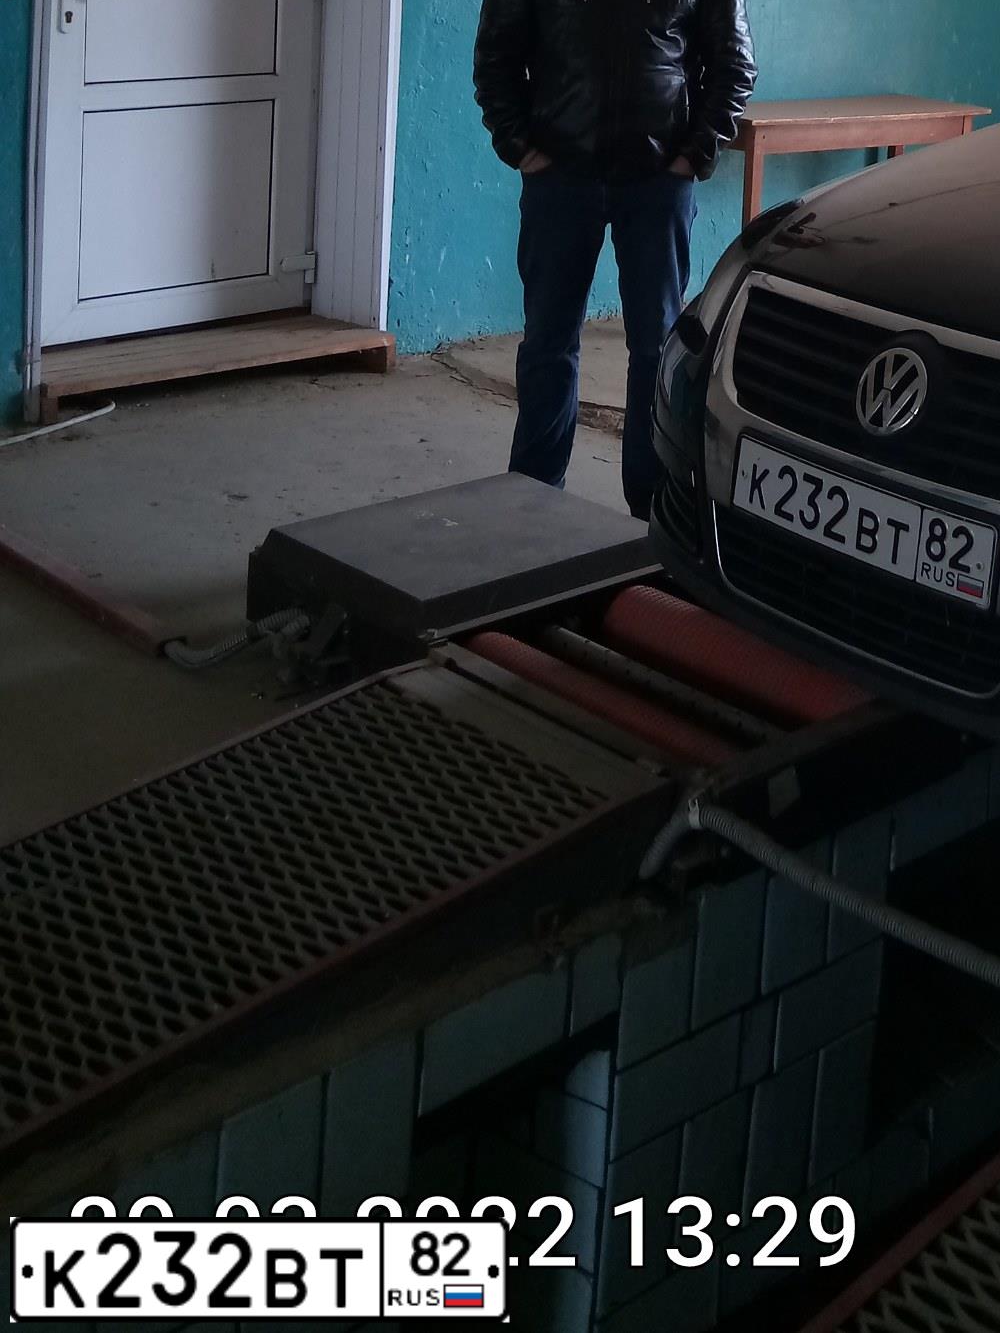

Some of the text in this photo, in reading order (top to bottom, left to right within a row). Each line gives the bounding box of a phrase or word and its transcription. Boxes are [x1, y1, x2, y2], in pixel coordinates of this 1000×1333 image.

[748, 463, 975, 574] К232ВТ 82
[920, 561, 955, 588] RUS
